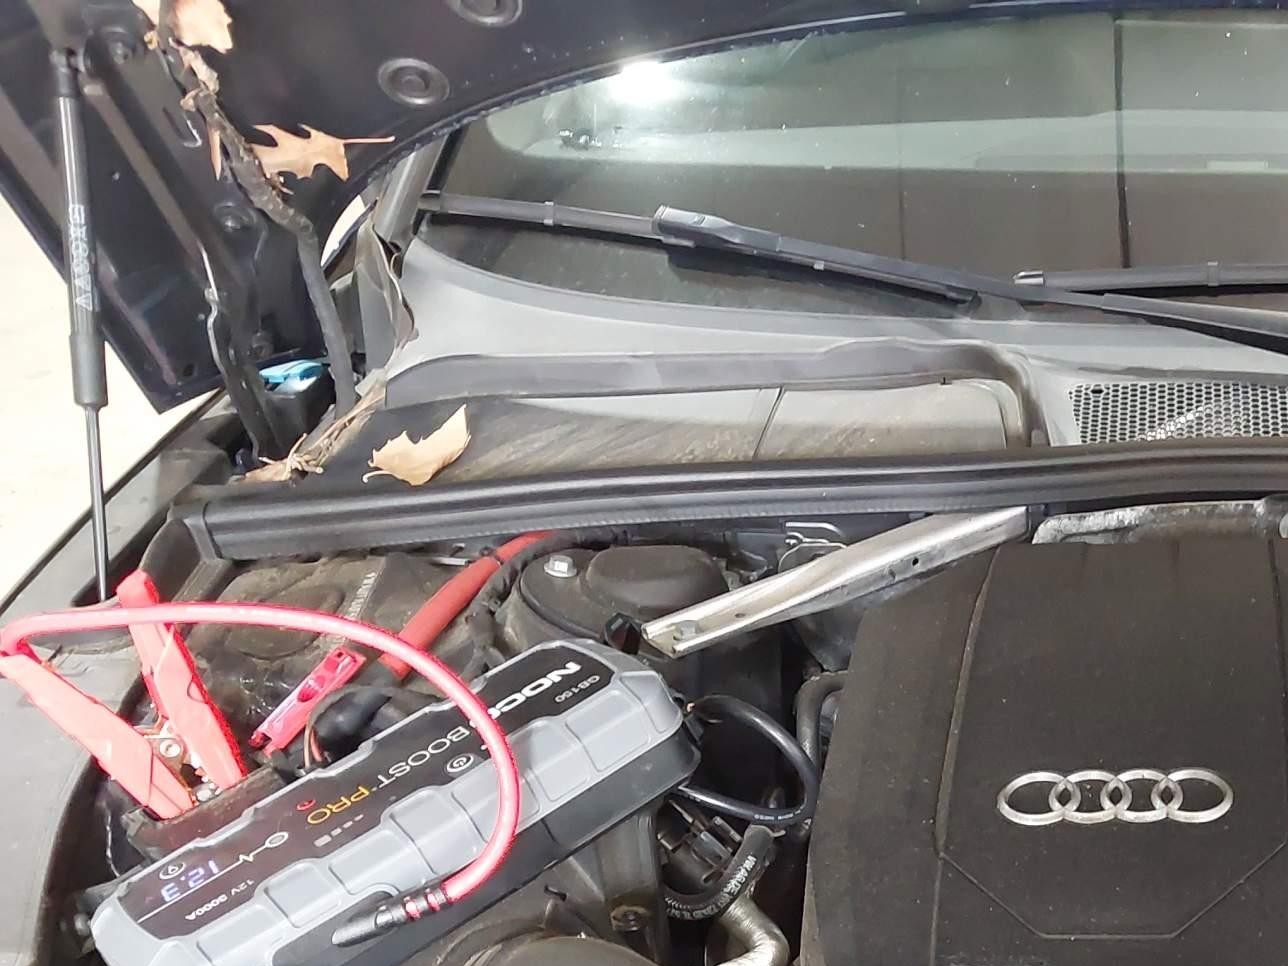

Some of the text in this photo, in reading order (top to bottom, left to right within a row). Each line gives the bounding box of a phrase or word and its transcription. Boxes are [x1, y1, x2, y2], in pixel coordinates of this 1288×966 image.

[554, 675, 600, 702] GB150
[377, 726, 470, 788] BOOST
[307, 786, 370, 825] PRO
[161, 860, 219, 902] 12.3
[231, 879, 254, 896] 12V
